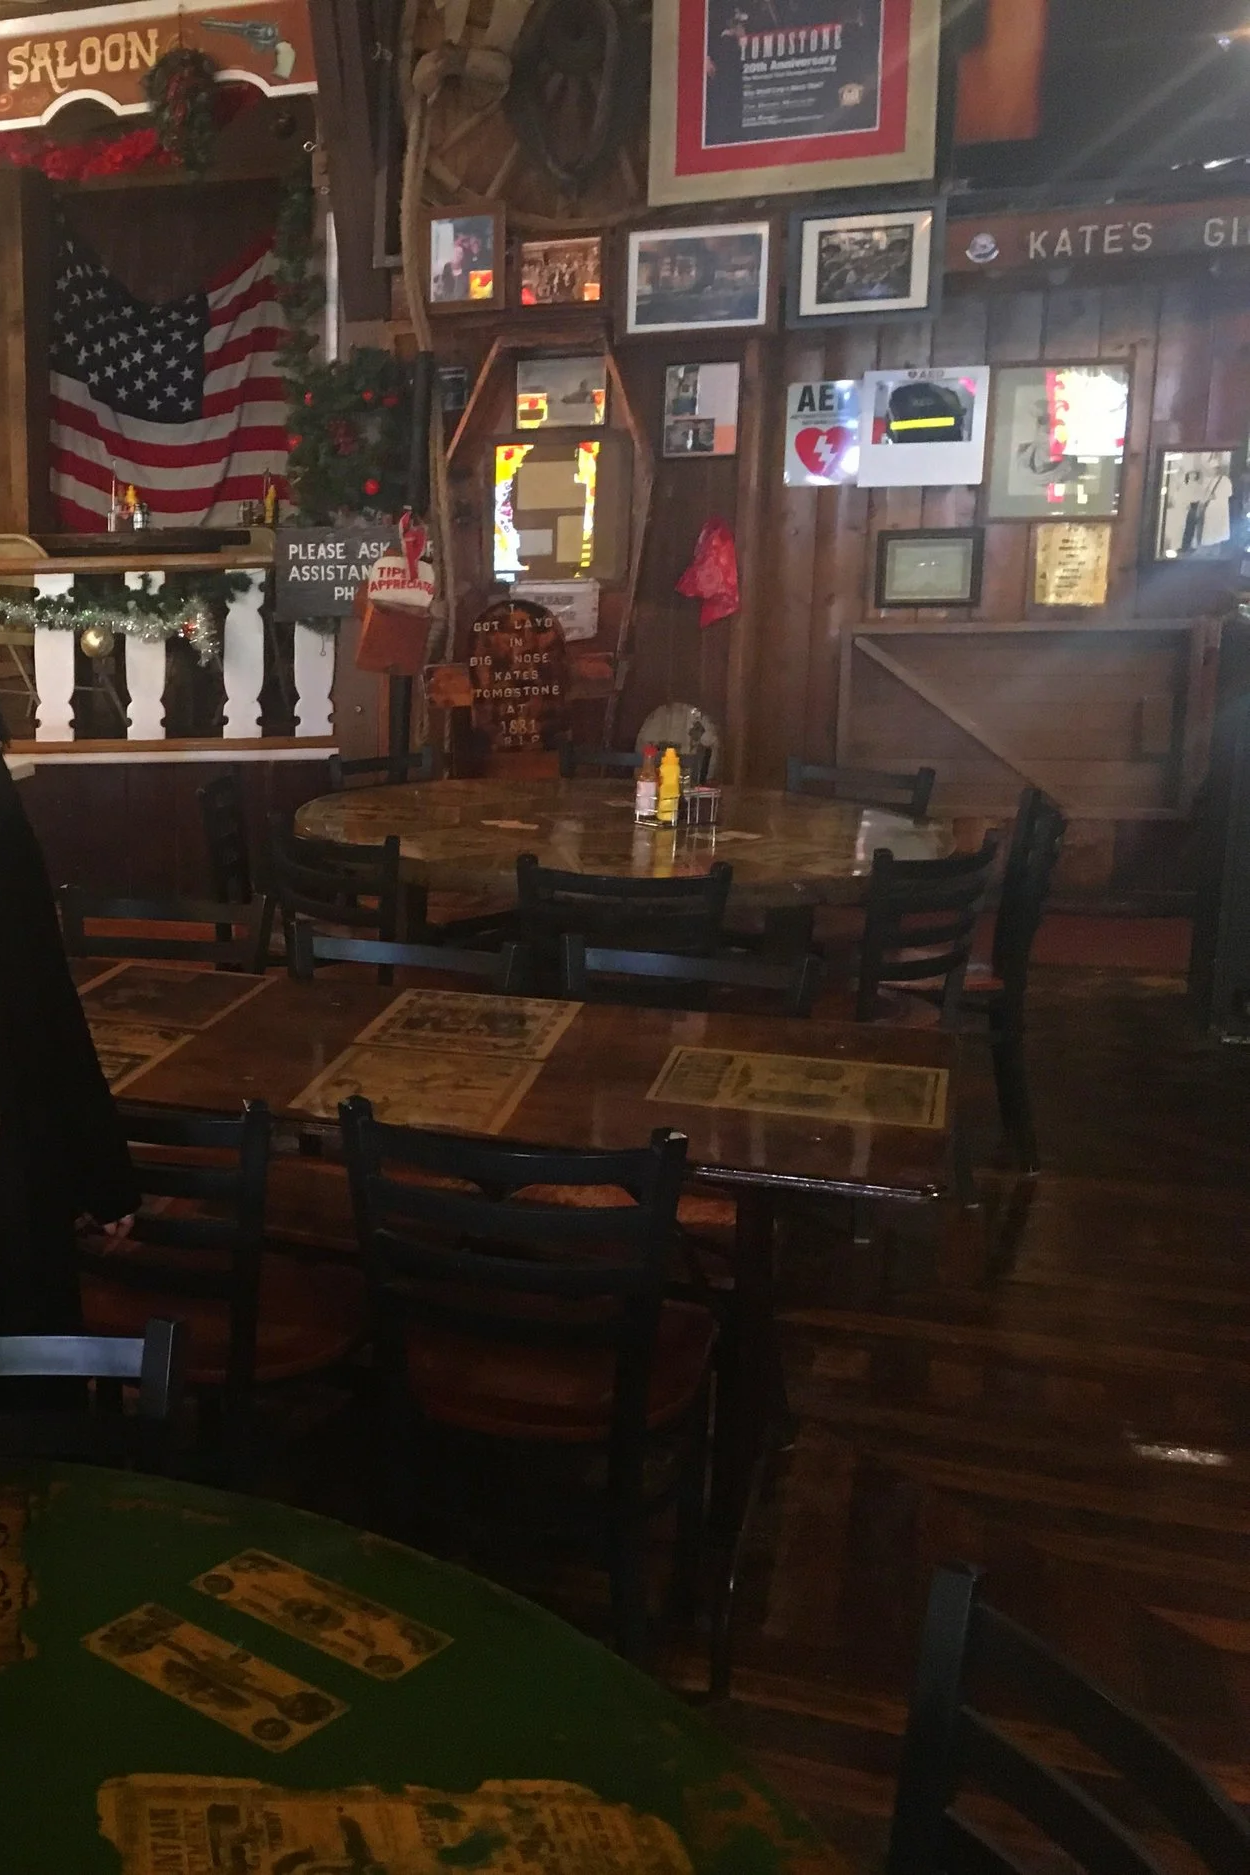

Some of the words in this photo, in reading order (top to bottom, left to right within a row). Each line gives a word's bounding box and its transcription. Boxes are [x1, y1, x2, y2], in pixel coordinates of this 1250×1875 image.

[739, 24, 843, 62] TOMBSTONE
[7, 28, 159, 93] SALOON
[741, 61, 768, 75] 20th
[769, 54, 838, 71] Anniversary
[1028, 221, 1154, 260] KATE'S
[1203, 216, 1250, 247] GI
[797, 383, 843, 413] AE
[288, 542, 346, 560] PLEASE
[357, 541, 391, 560] ASK
[288, 563, 373, 582] ASSISTAN
[334, 586, 355, 601] PH
[473, 620, 500, 632] GOT
[509, 637, 523, 648] IN
[469, 656, 493, 667] BIG
[513, 652, 550, 664] NOSE
[494, 670, 539, 682] KATES
[475, 684, 561, 699] TOMBSTONE
[506, 703, 527, 715] AT
[500, 718, 538, 736] 1881
